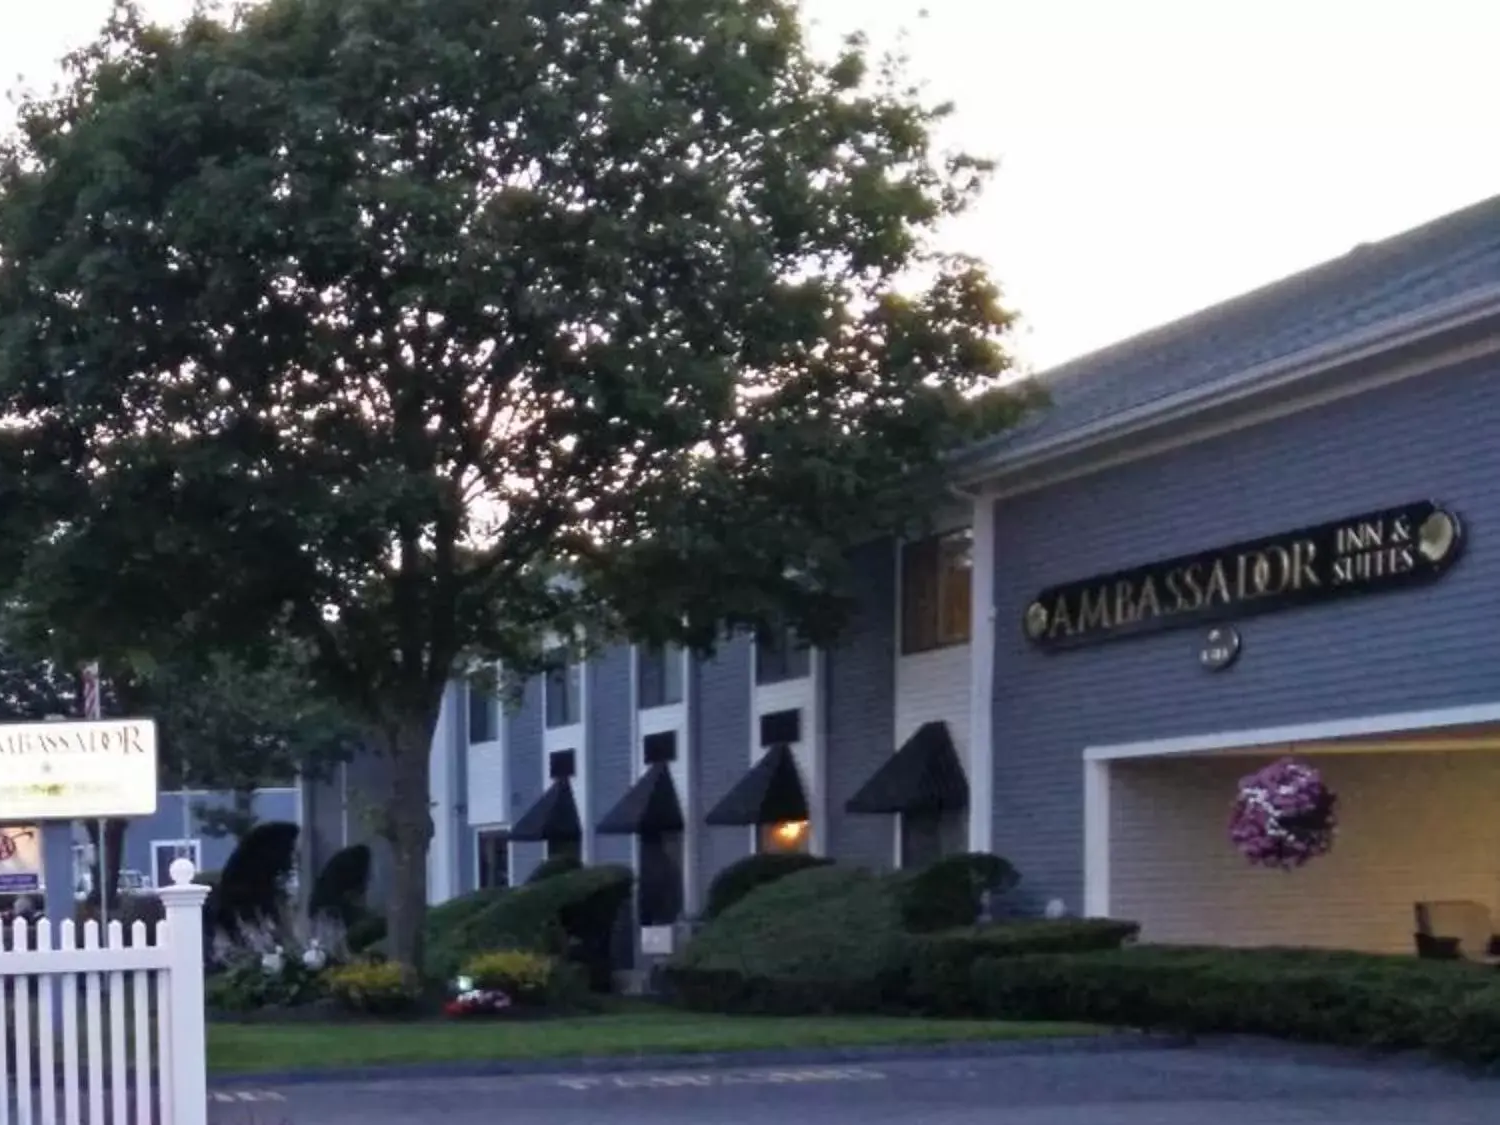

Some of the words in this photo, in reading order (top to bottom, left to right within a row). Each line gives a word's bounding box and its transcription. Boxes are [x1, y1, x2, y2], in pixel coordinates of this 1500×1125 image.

[1336, 519, 1383, 554] INN
[1390, 514, 1412, 543] &
[1334, 544, 1414, 584] SUITES
[1051, 542, 1321, 639] AMBASSADOR
